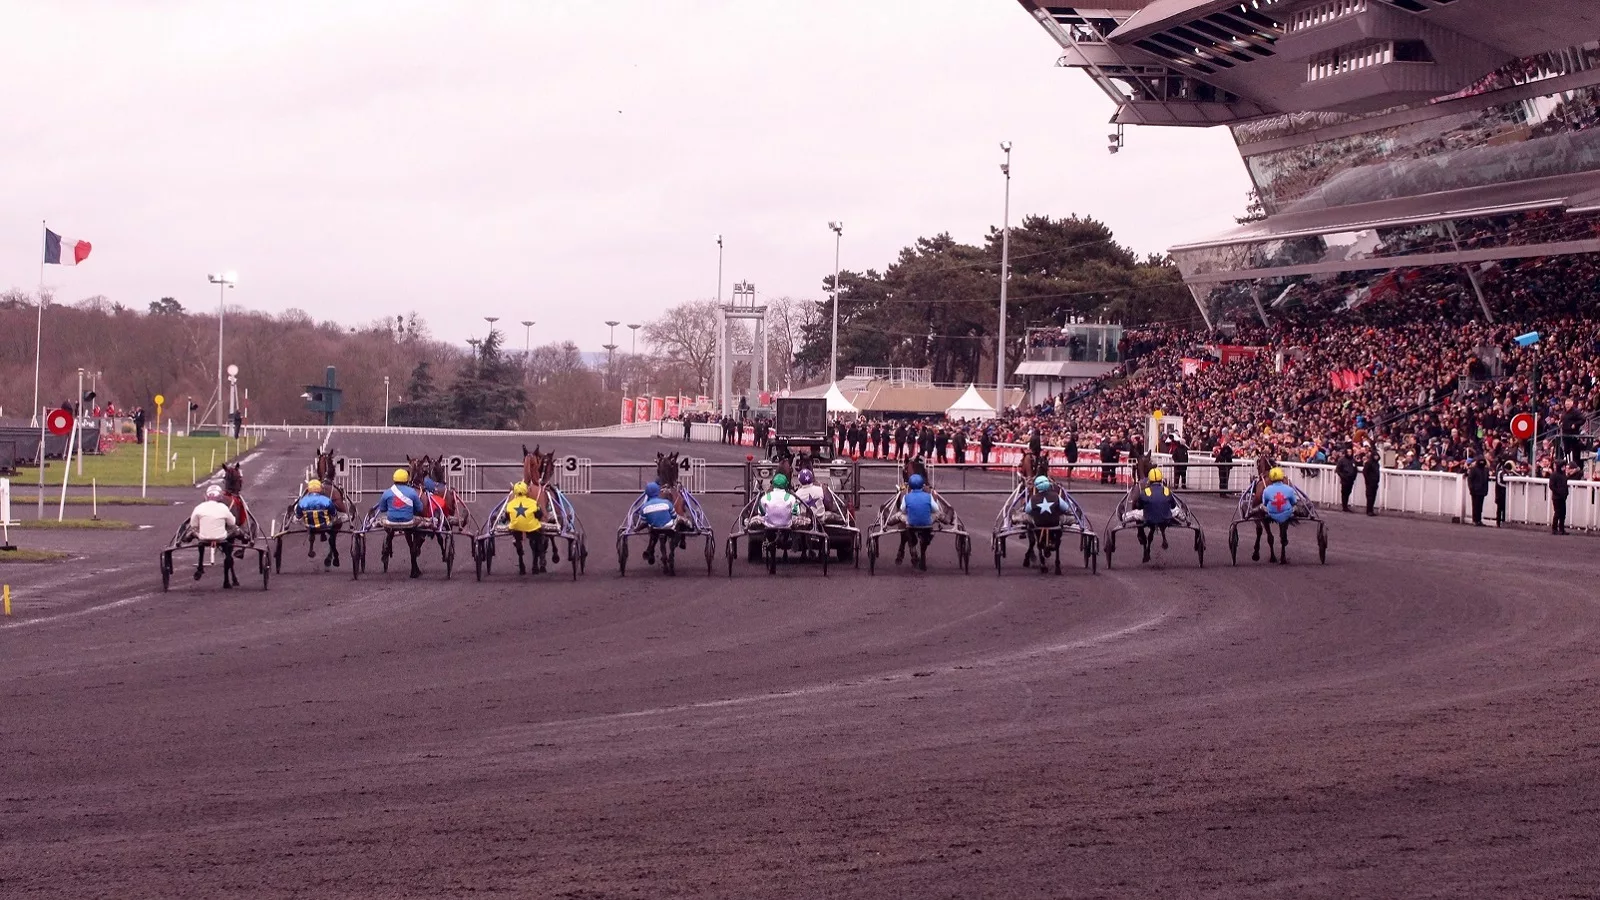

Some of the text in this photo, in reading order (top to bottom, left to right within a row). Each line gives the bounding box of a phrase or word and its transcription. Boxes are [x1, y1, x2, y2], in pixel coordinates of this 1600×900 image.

[336, 458, 345, 471] 1
[451, 457, 462, 471] 2
[566, 457, 577, 471] 3
[679, 458, 690, 471] 4
